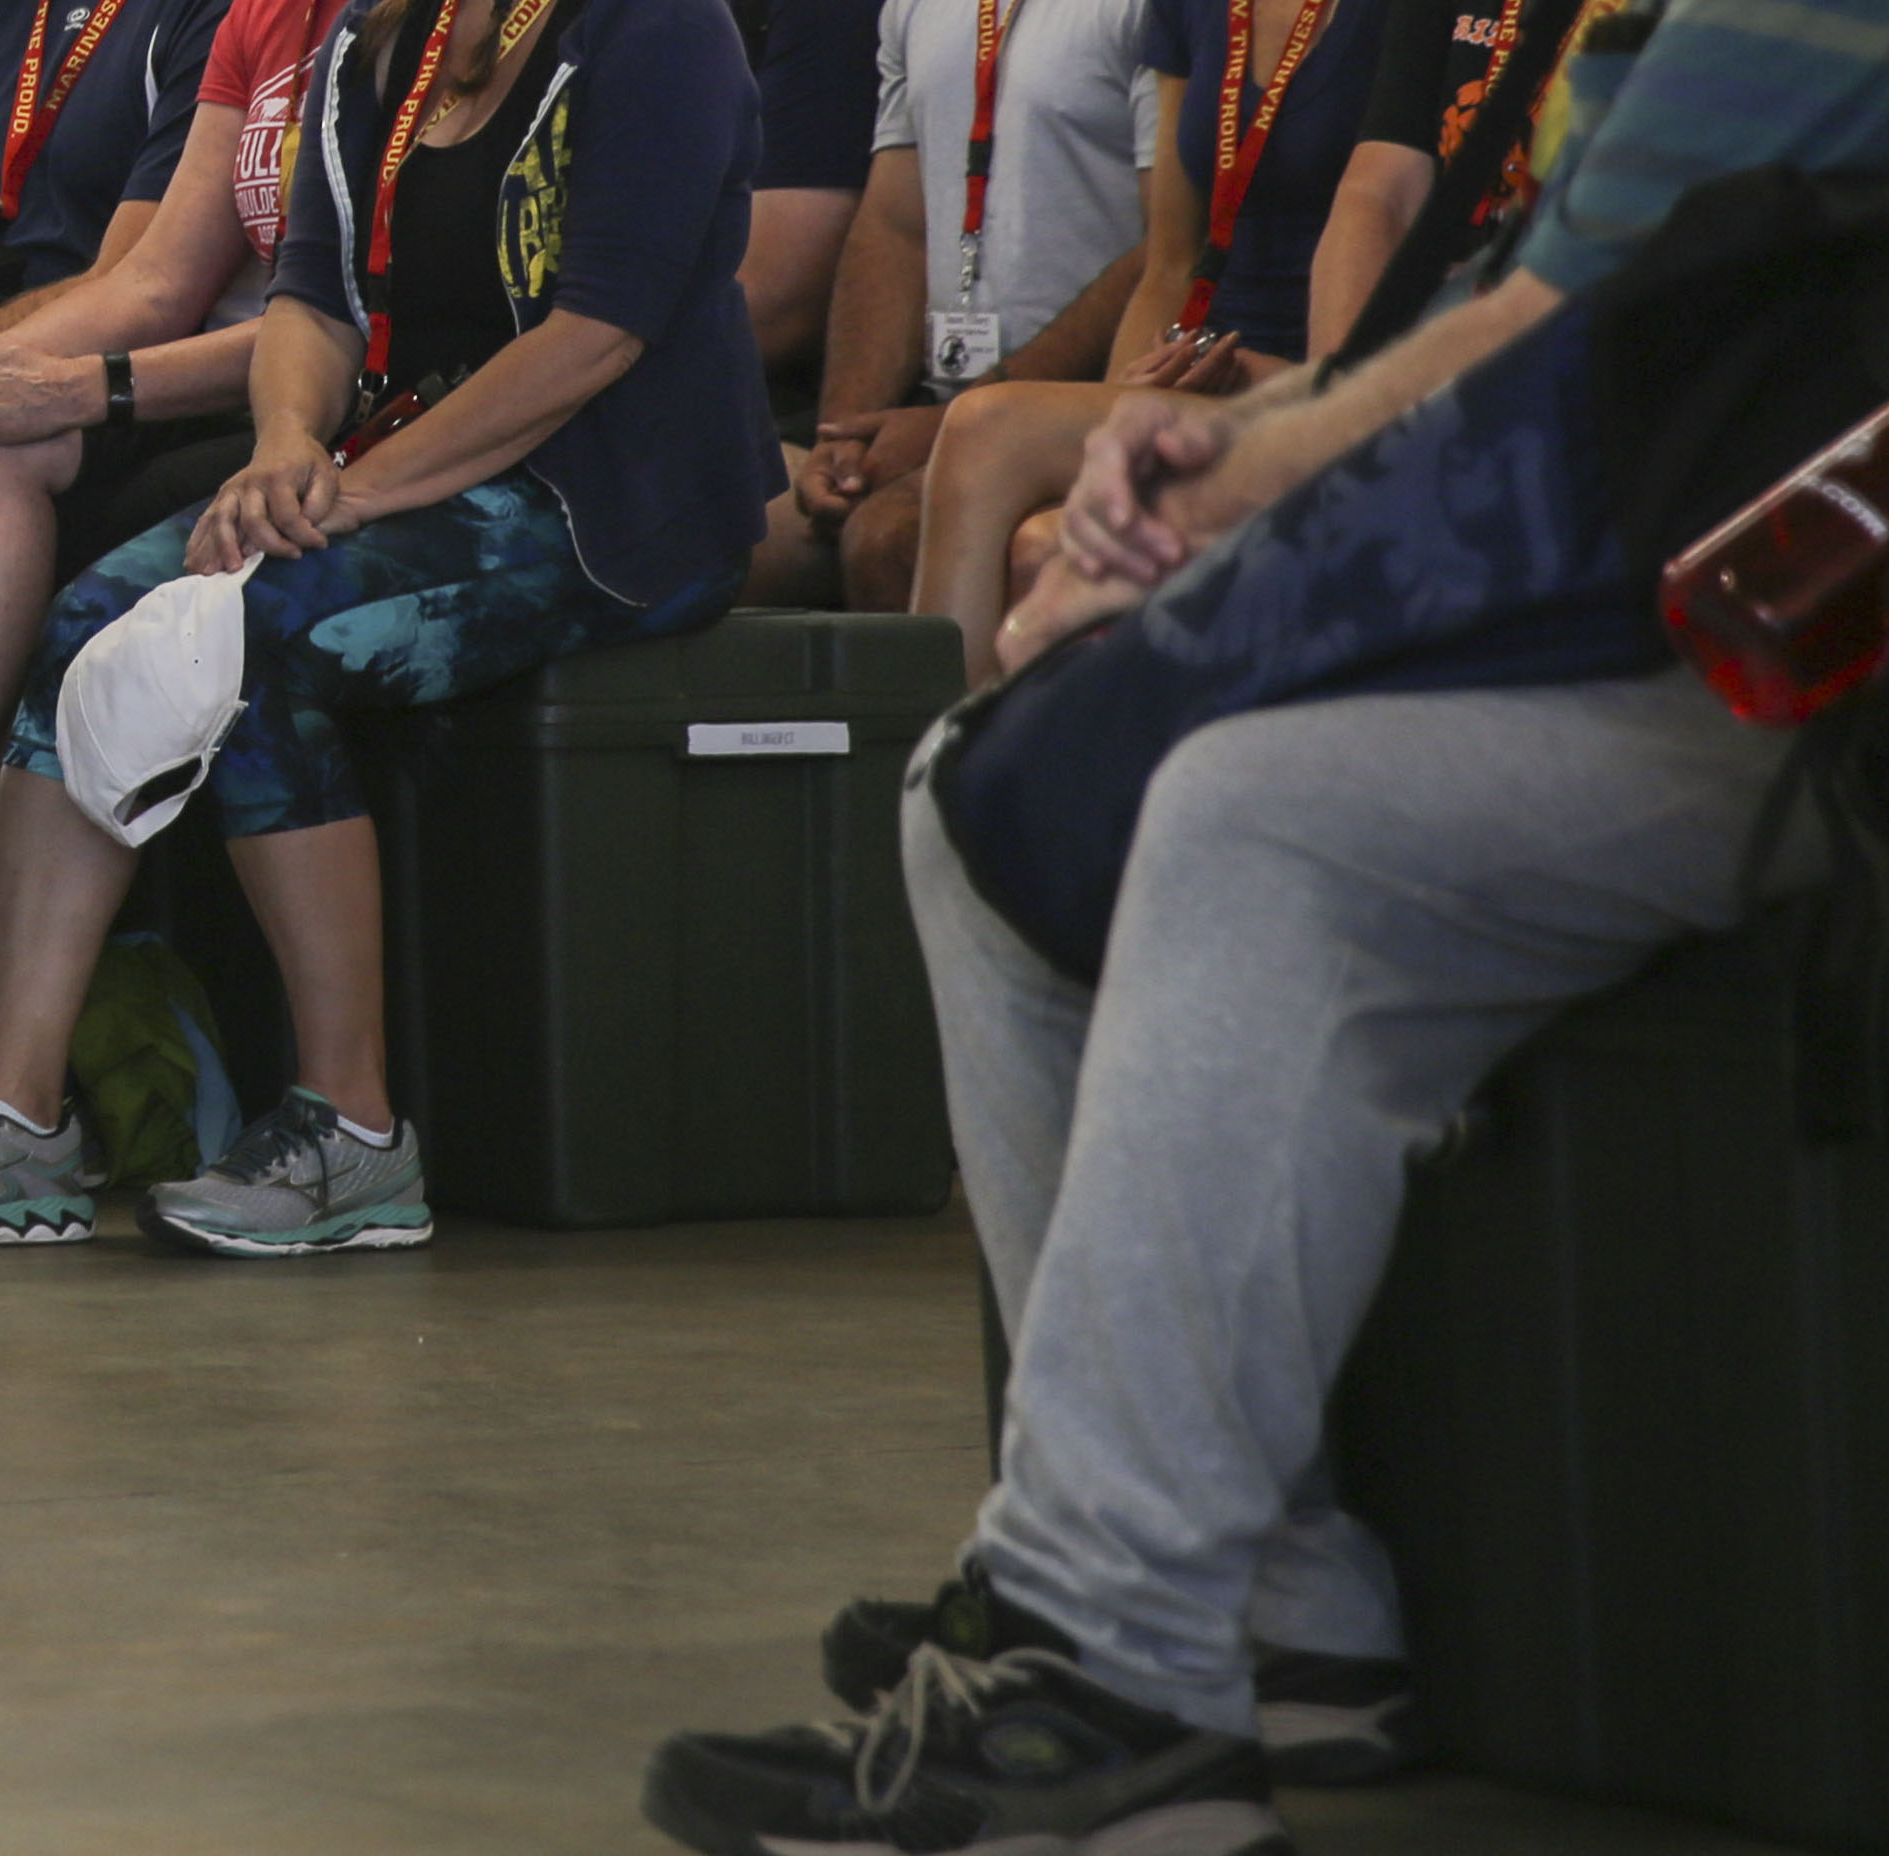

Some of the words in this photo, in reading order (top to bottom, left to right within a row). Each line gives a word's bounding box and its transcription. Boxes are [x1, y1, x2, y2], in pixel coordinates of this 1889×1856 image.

[412, 44, 443, 95] THE
[1225, 29, 1248, 81] THE
[11, 57, 39, 138] PROUD.
